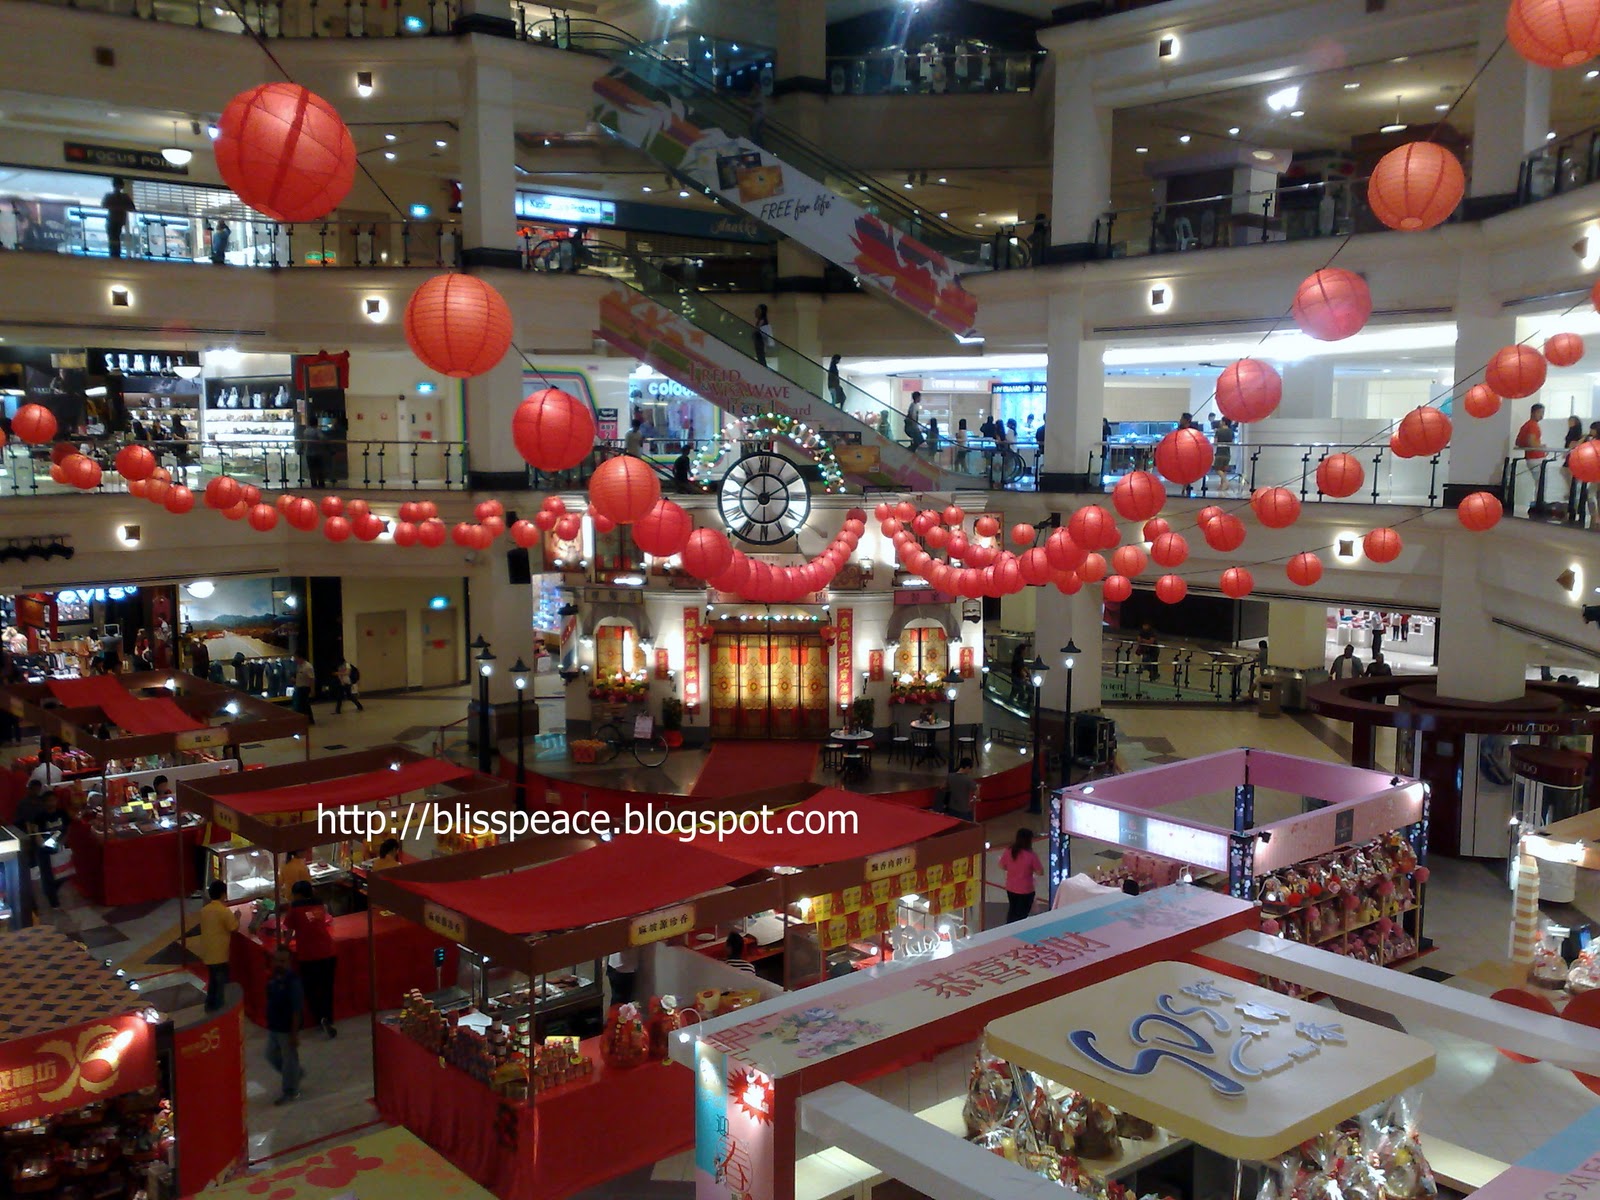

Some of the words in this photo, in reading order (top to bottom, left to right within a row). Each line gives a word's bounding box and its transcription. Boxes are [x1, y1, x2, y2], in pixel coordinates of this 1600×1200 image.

[87, 149, 137, 163] FOCUS
[760, 199, 795, 220] FREE
[794, 199, 811, 221] for
[1502, 722, 1560, 733] SHISEIDO
[914, 931, 1111, 1000] 恭喜發財
